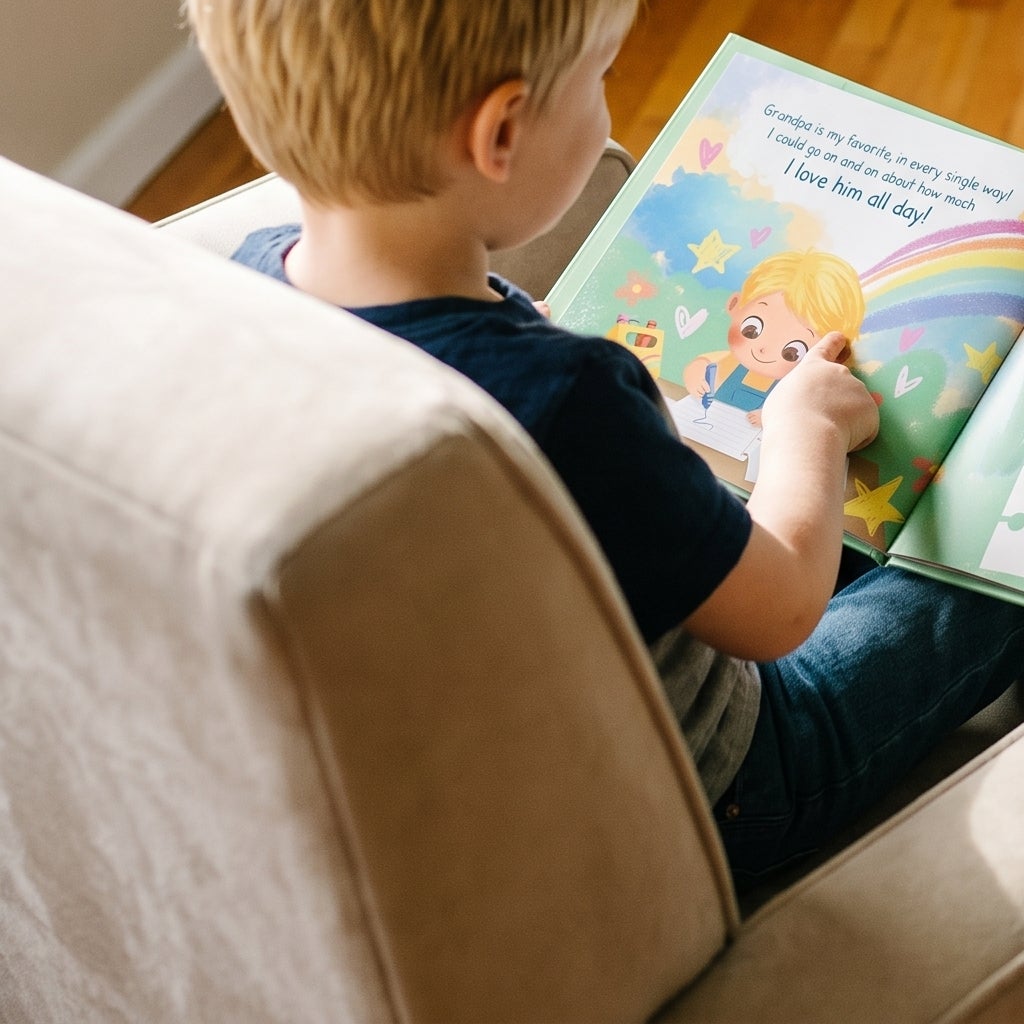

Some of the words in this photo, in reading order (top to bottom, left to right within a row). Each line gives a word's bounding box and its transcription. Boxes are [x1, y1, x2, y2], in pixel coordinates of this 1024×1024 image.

[764, 104, 812, 132] Grandpa
[814, 123, 823, 136] is
[827, 130, 844, 146] my
[847, 134, 892, 164] favorite,
[896, 152, 907, 165] in
[910, 160, 942, 181] every
[945, 171, 980, 192] single
[767, 128, 775, 139] I
[776, 132, 806, 151] could
[805, 146, 820, 158] go
[824, 151, 838, 163] on
[840, 156, 864, 172] and
[864, 166, 878, 178] on
[882, 172, 916, 190] about
[917, 182, 942, 200] how
[784, 158, 795, 174] I
[794, 162, 828, 189] love
[832, 176, 862, 202] him
[868, 191, 892, 210] all
[892, 200, 933, 228] day!
